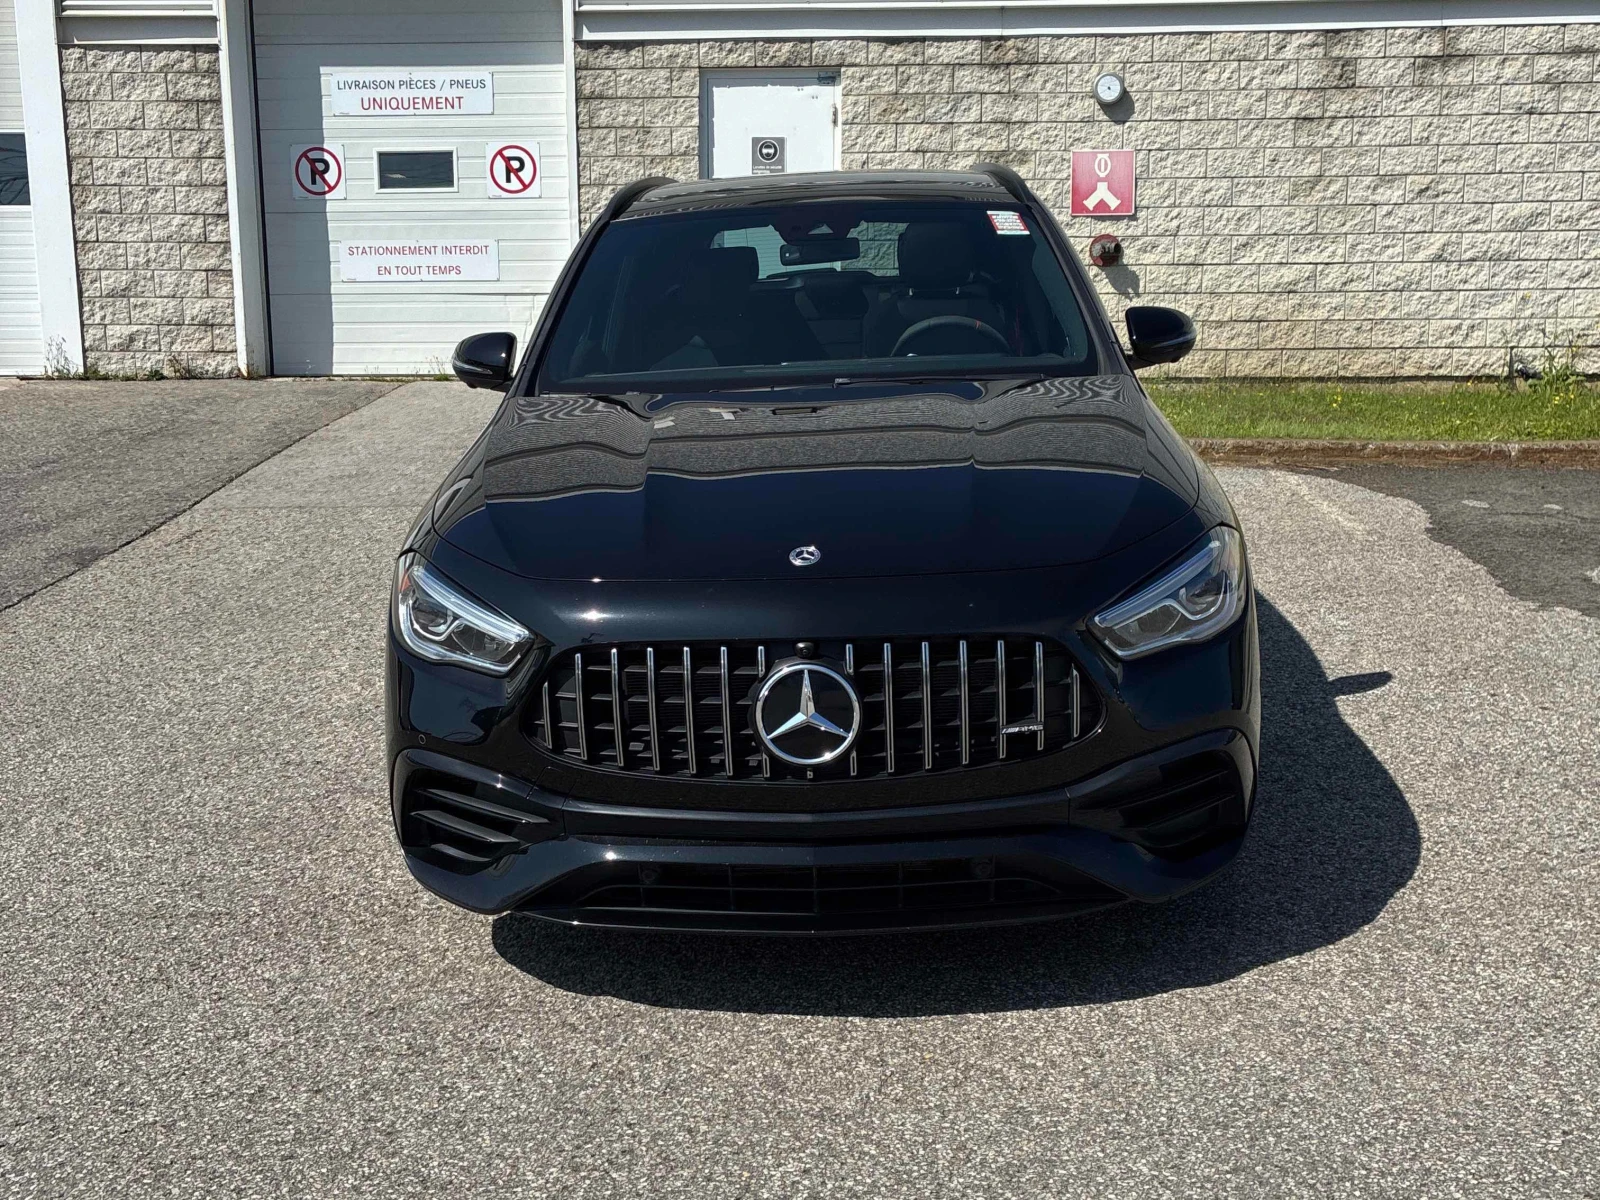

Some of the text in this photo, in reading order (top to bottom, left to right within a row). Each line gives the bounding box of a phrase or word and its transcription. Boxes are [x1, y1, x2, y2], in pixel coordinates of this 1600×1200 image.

[336, 77, 487, 92] LIVRAISON PIÈCES / PNEUS
[360, 95, 465, 111] UNIQUEMENT
[310, 157, 330, 186] P
[505, 156, 525, 184] P
[347, 244, 490, 257] STATIONNEMENT INTERDIT
[377, 265, 462, 276] EN TOUT TEMPS
